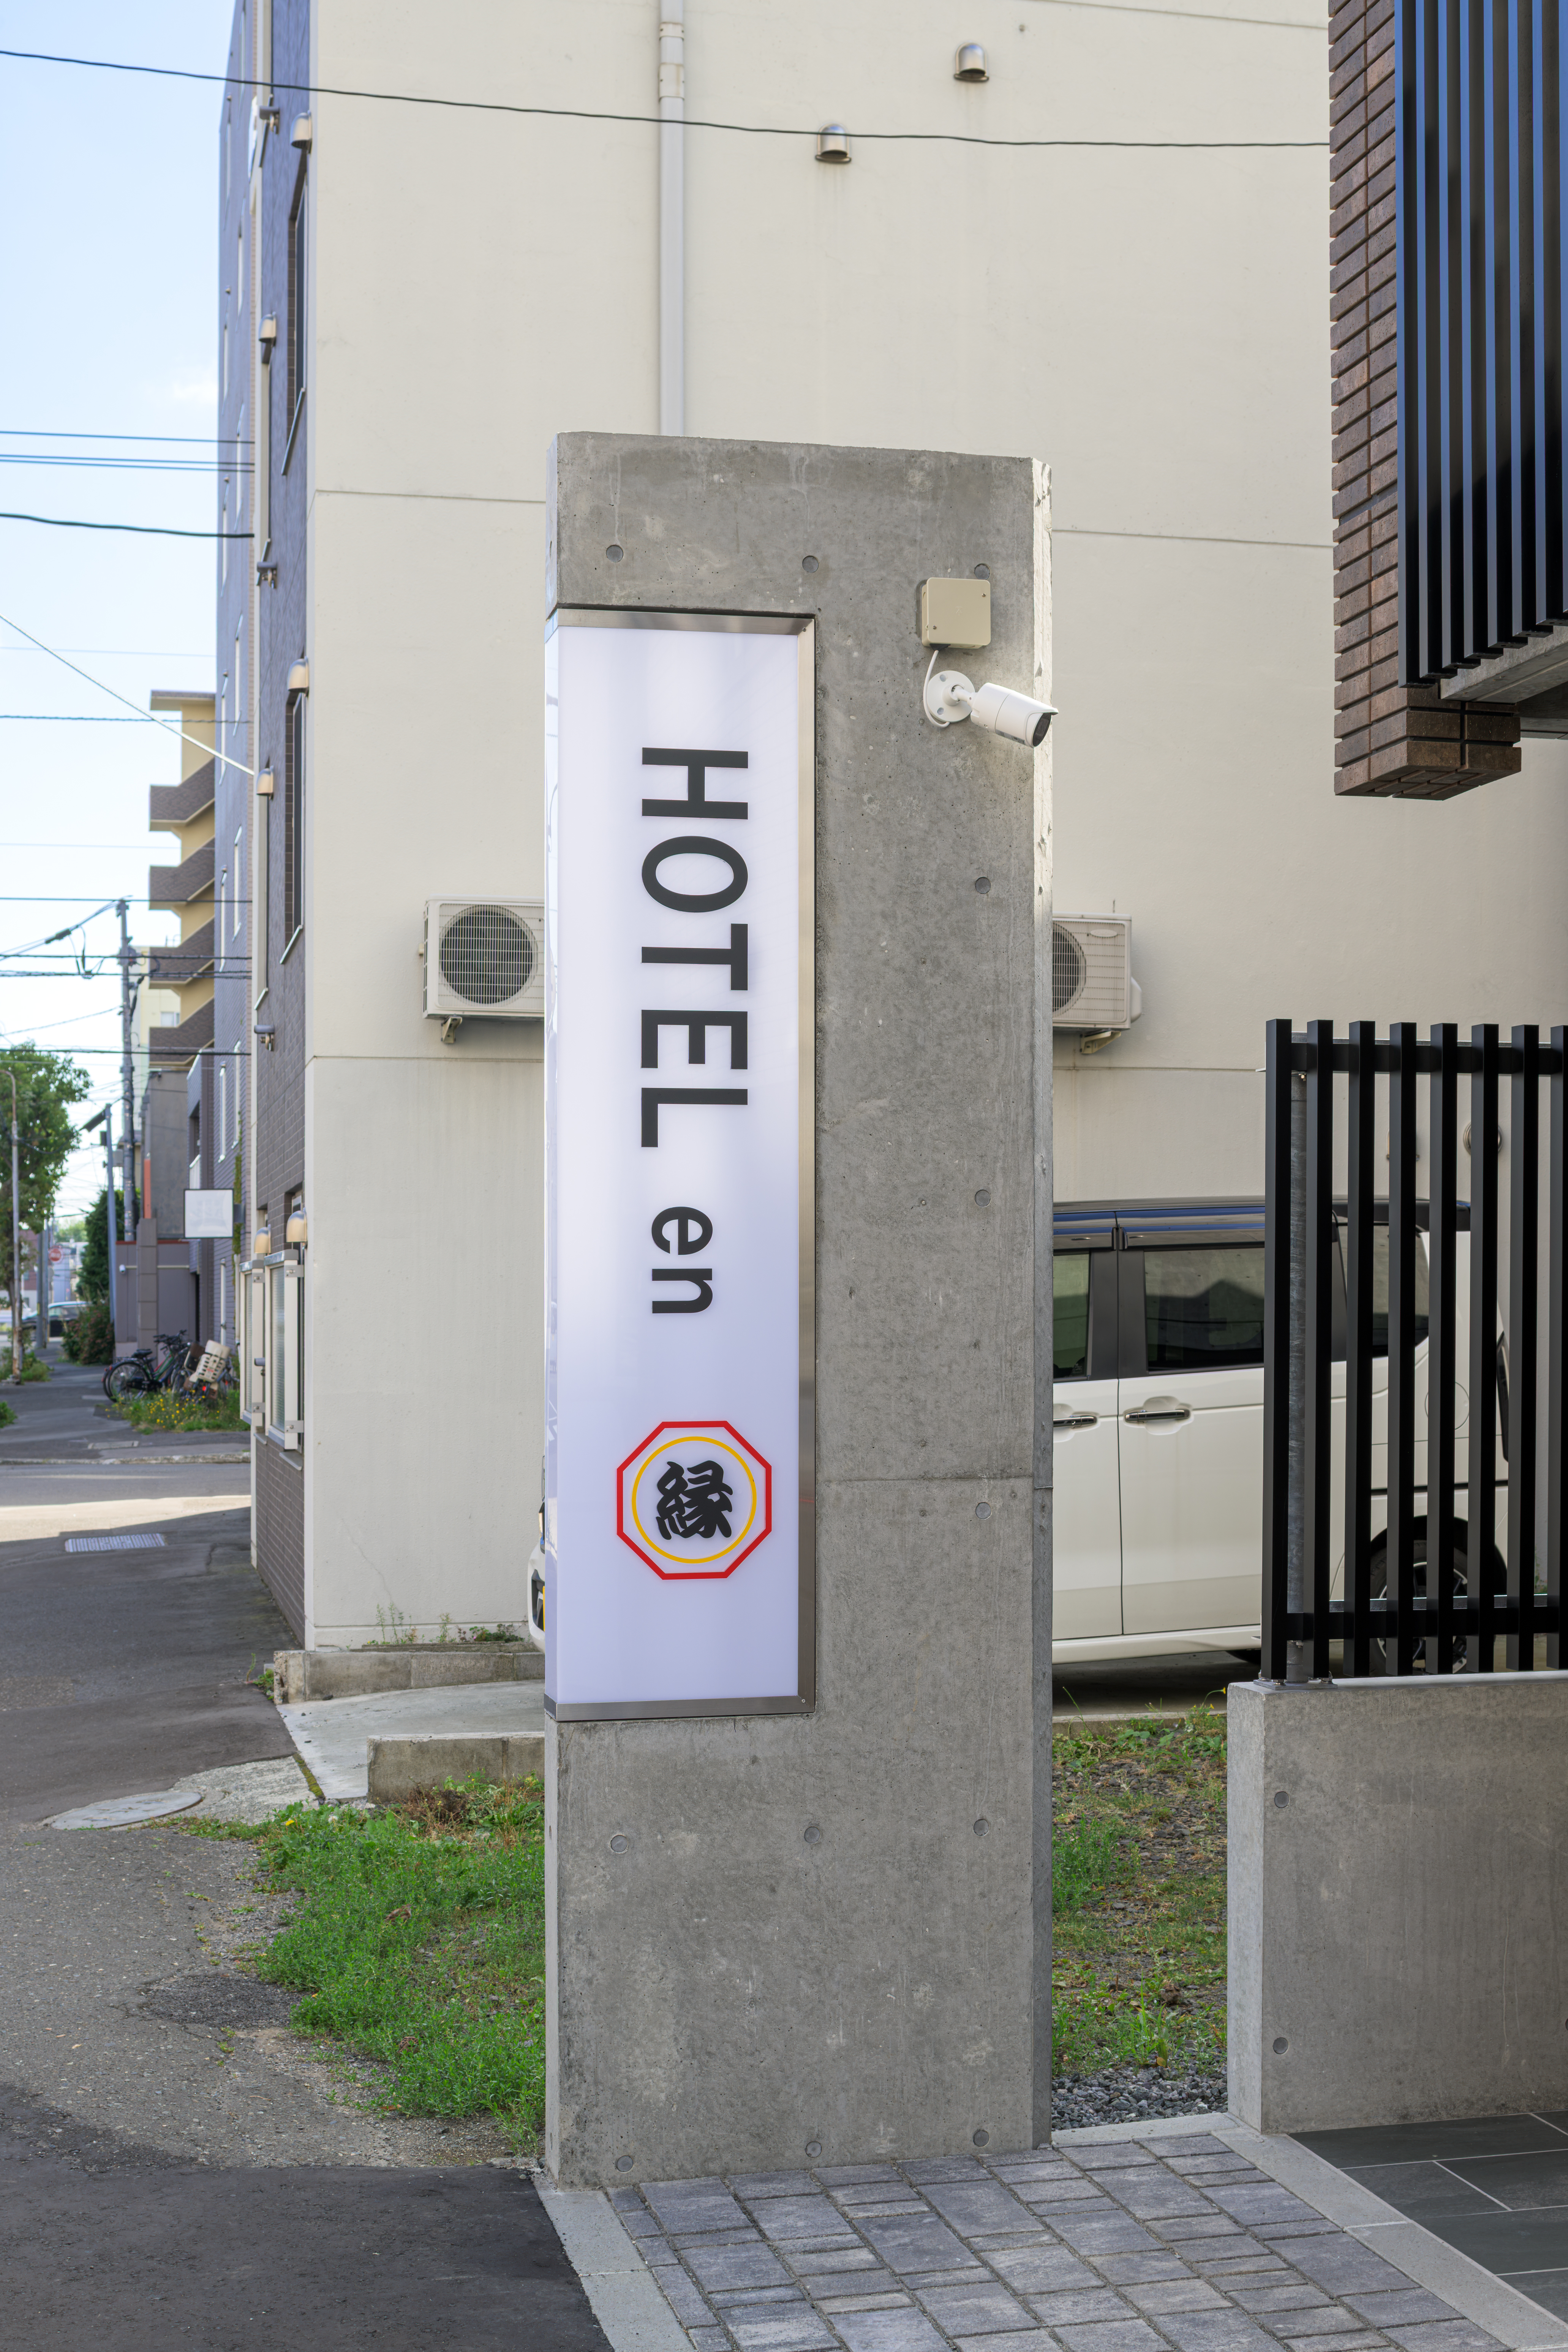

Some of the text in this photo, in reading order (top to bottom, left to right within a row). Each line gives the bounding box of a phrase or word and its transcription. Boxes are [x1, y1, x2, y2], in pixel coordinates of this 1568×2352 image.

[641, 747, 748, 1314] HOTEL en
[656, 1460, 733, 1540] 縁
